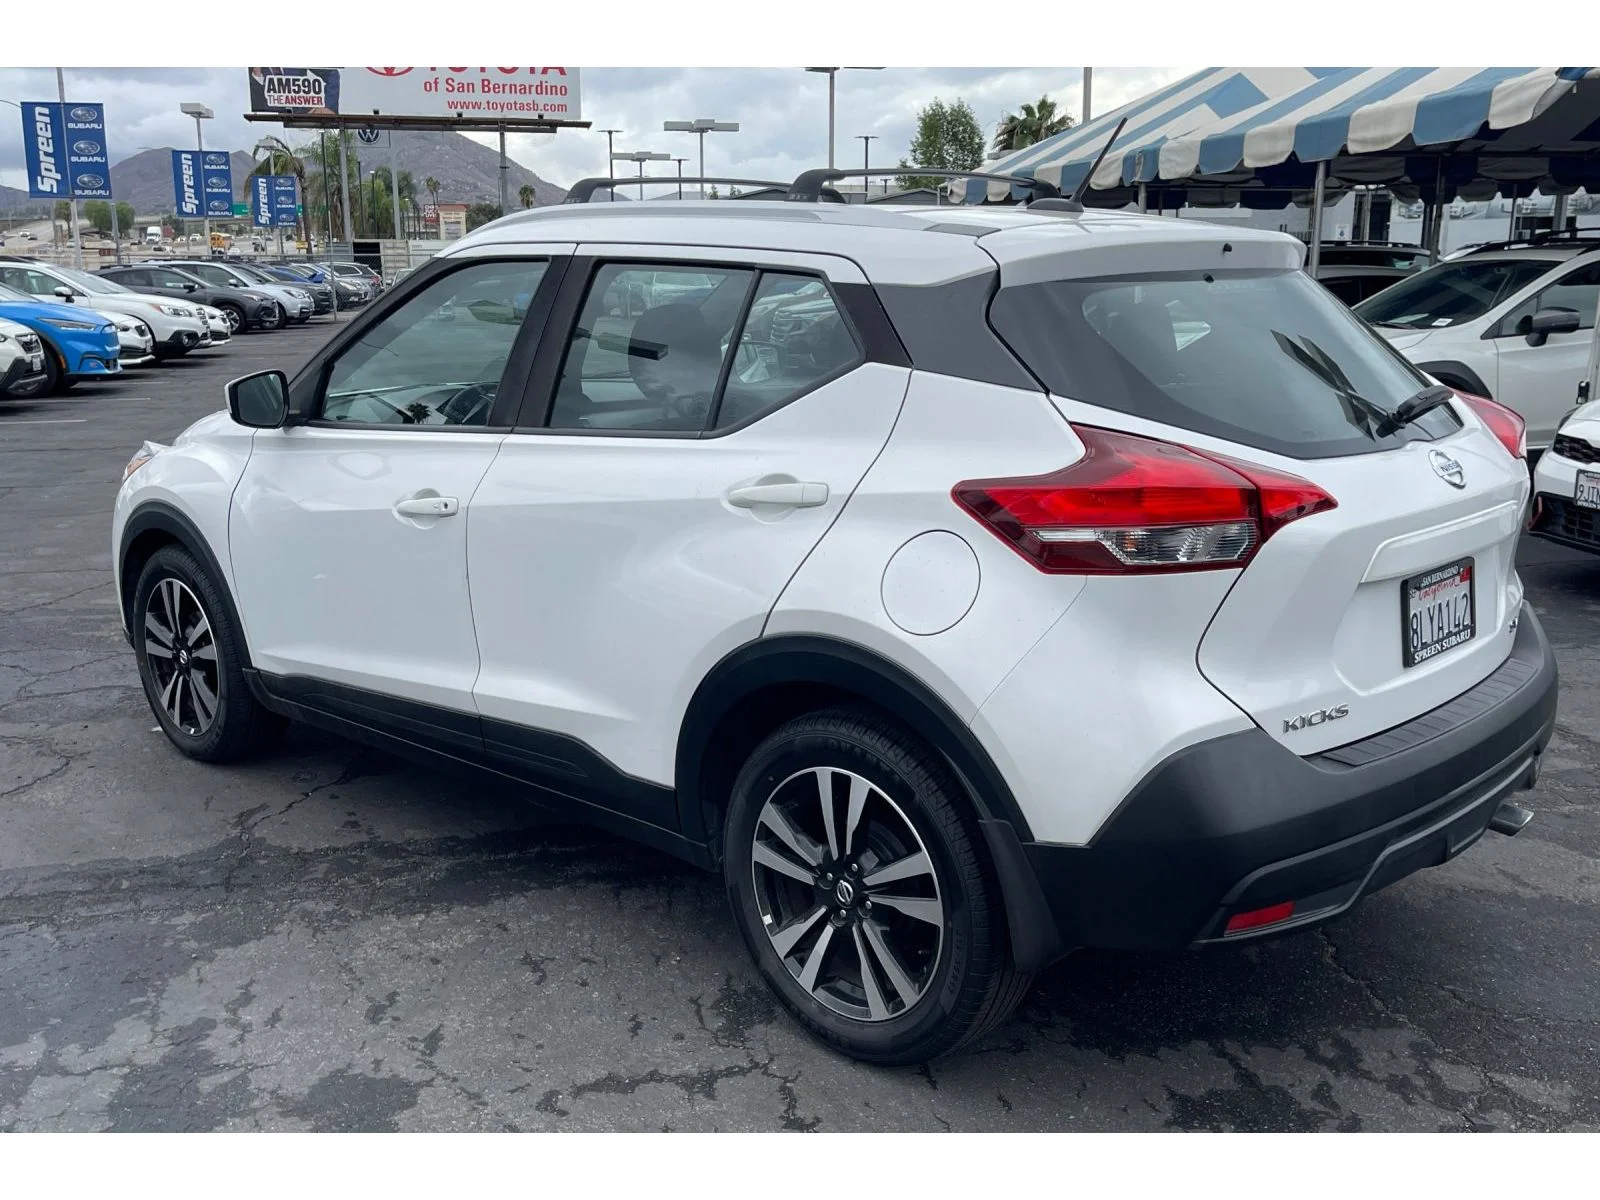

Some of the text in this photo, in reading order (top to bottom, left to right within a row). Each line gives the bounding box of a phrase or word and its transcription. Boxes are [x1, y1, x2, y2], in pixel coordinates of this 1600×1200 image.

[266, 77, 322, 95] AM590
[424, 77, 568, 97] of San Bernardino
[447, 100, 568, 113] www.toyotasb.com
[34, 106, 62, 194] Spreen
[181, 153, 199, 215] Spreen
[258, 178, 272, 225] Spreen
[1411, 592, 1469, 650] 8LYA142
[1414, 629, 1471, 663] SPREEN SUBARU
[1283, 702, 1349, 733] KICKS
